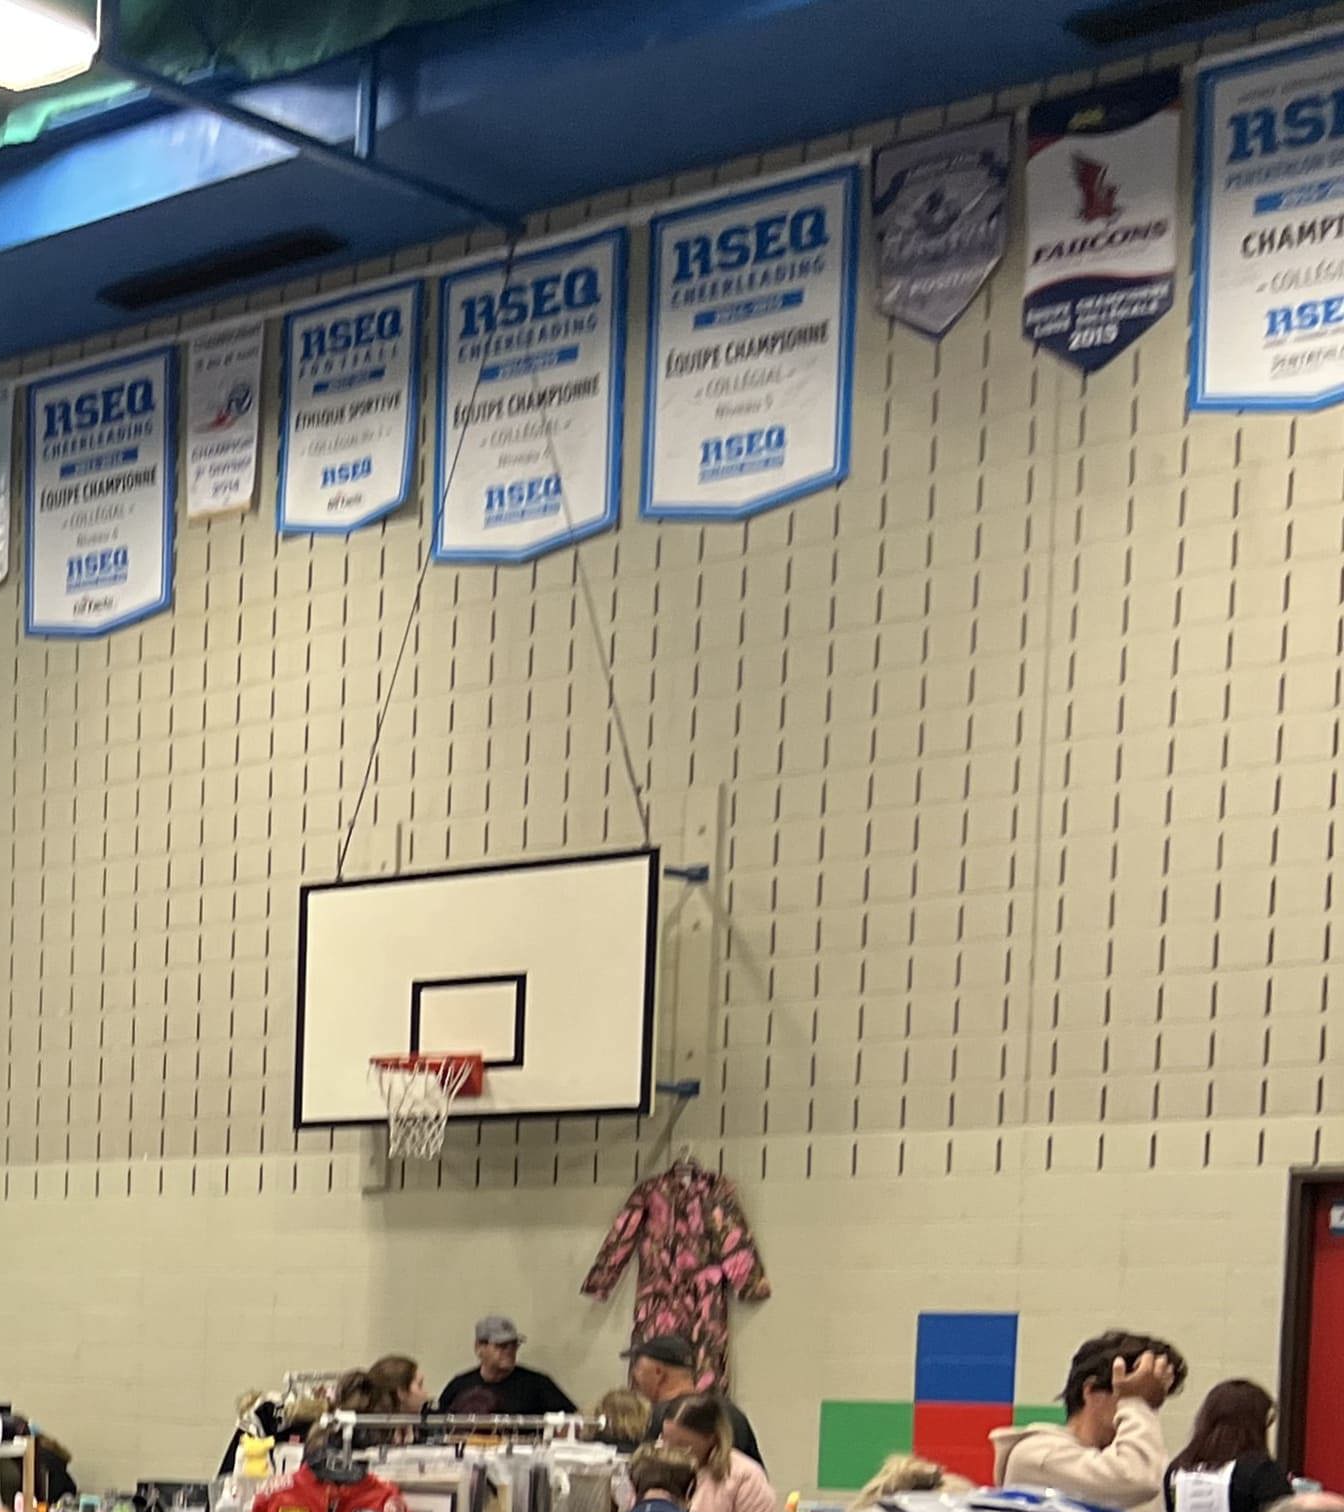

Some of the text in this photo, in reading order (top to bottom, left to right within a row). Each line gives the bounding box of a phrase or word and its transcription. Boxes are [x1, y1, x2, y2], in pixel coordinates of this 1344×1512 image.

[672, 205, 830, 284] RSEQ
[299, 306, 403, 362] RSEQ
[460, 265, 603, 338] RSEQ
[42, 375, 156, 442] RSEQ
[700, 424, 787, 465] RSEQ
